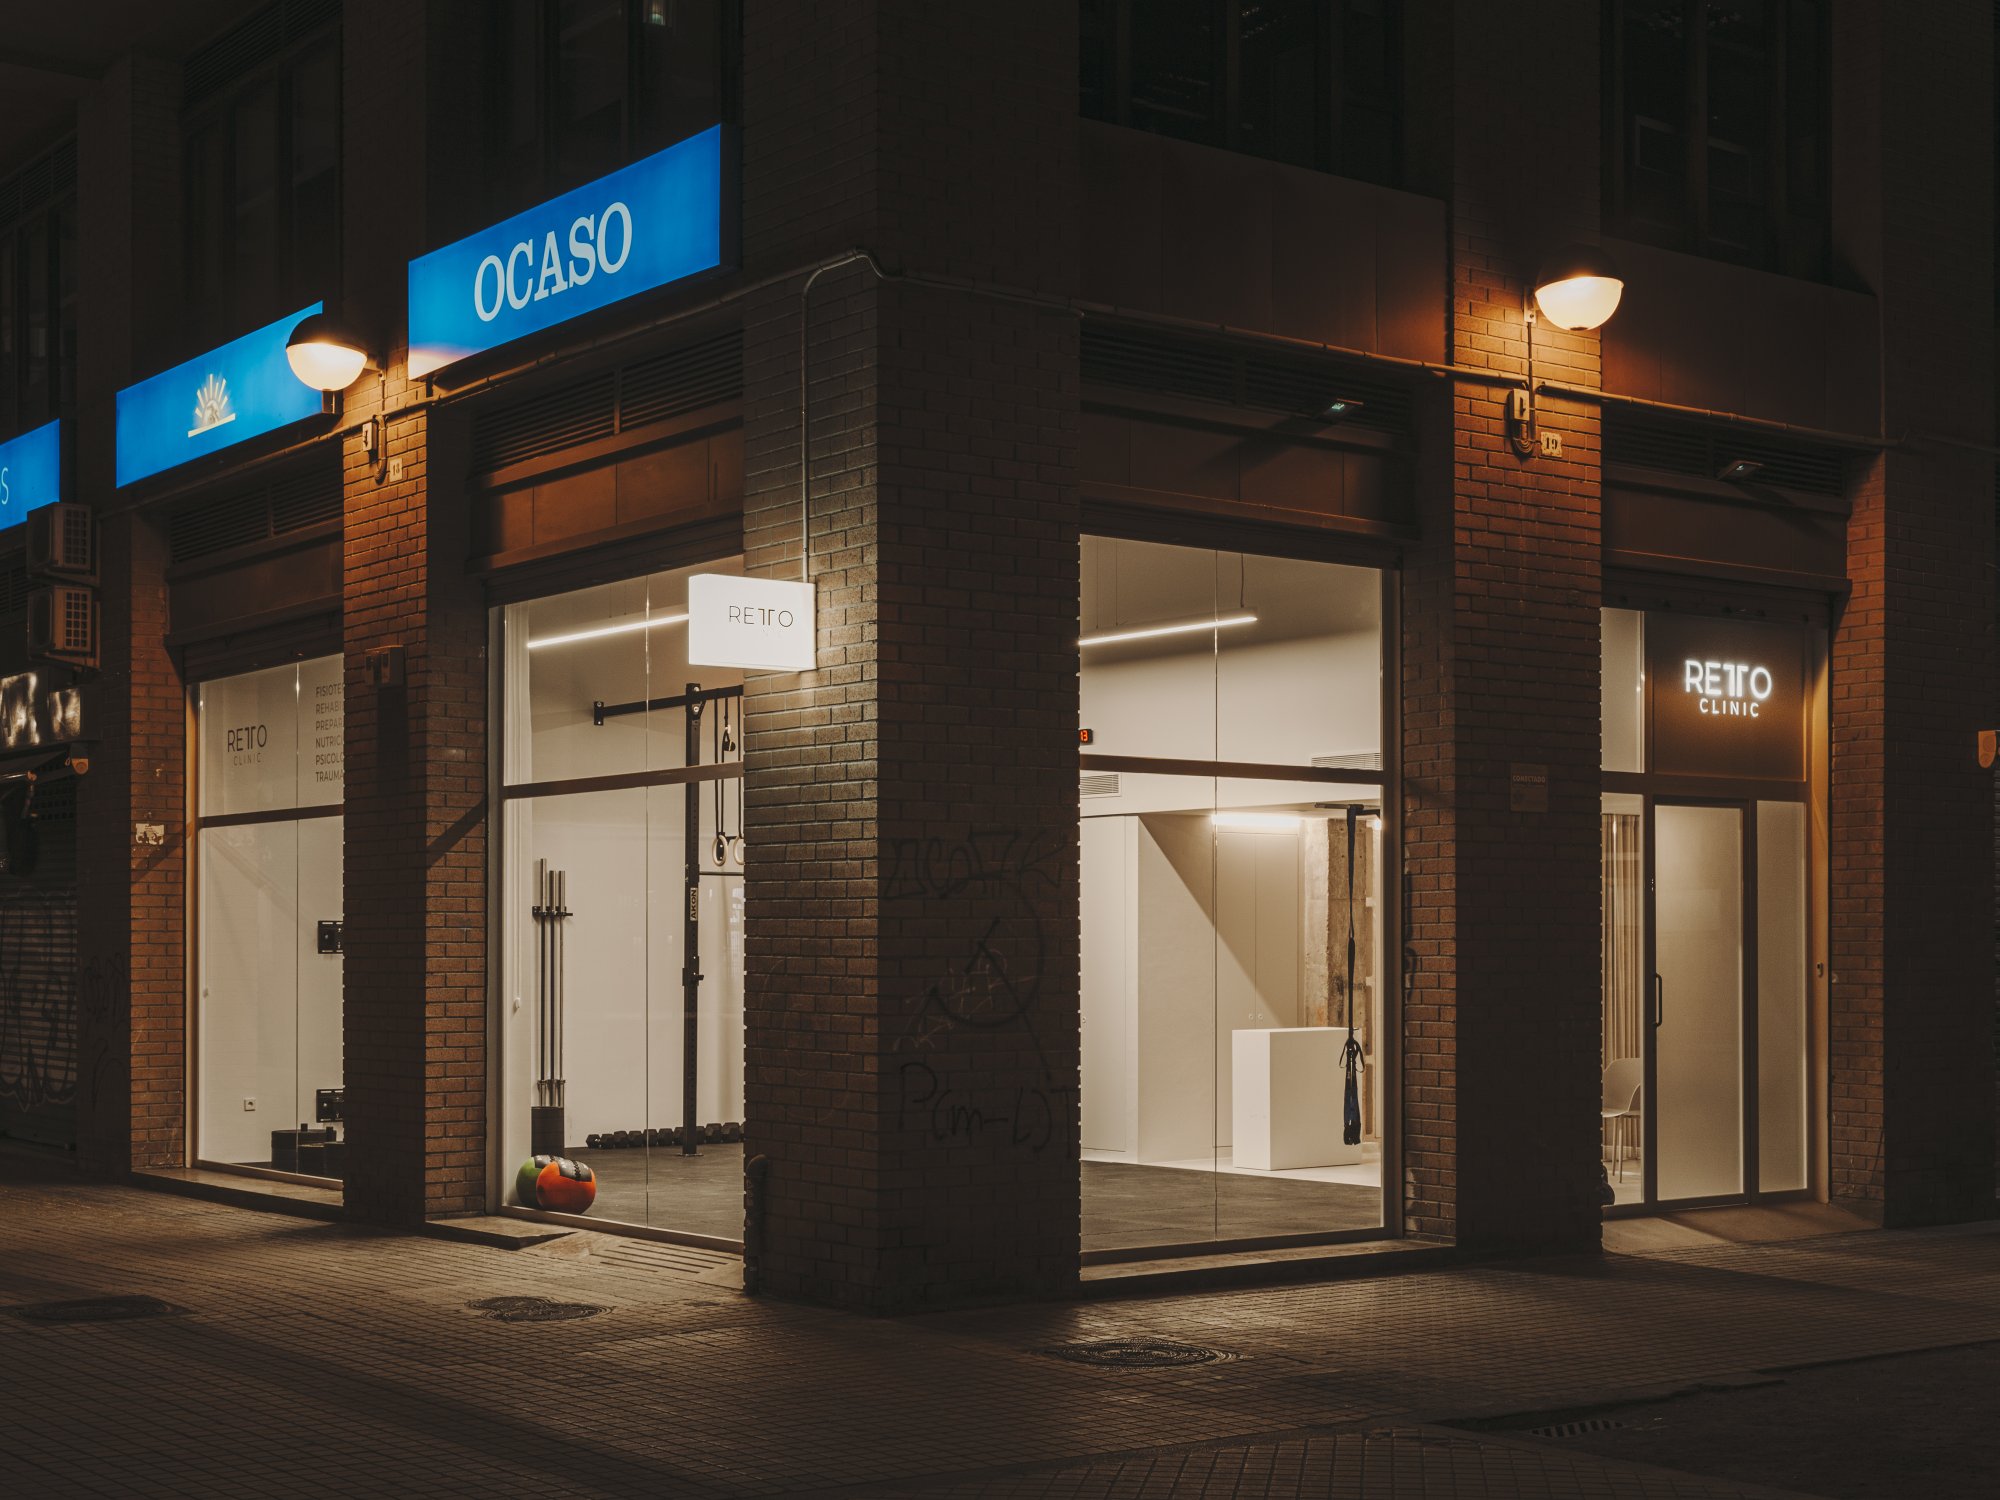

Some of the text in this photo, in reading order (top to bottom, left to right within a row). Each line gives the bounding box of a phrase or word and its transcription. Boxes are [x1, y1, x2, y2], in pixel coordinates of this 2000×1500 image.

[474, 202, 632, 322] OCASO
[1546, 437, 1558, 450] 19
[0, 467, 9, 505] S
[729, 605, 793, 628] RETTO
[1685, 660, 1772, 699] RETTO
[1700, 698, 1759, 717] CLINIC
[315, 717, 344, 732] PREPAR
[227, 724, 267, 752] RETTO
[233, 752, 262, 766] CLINIC
